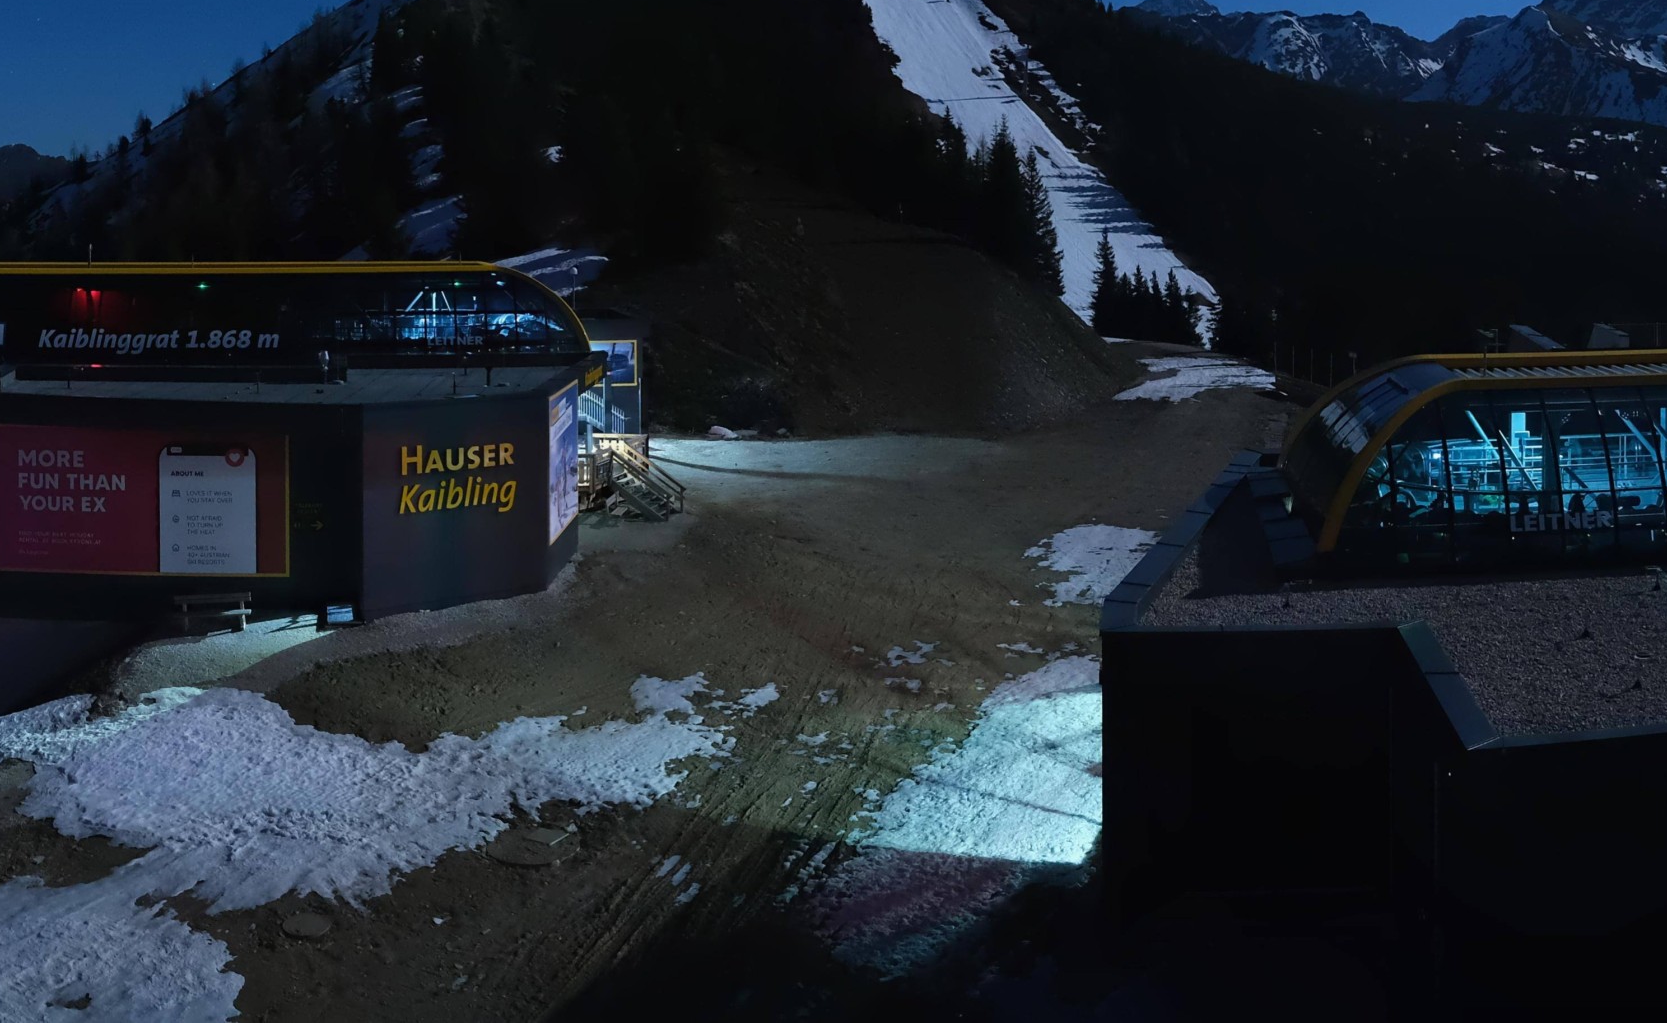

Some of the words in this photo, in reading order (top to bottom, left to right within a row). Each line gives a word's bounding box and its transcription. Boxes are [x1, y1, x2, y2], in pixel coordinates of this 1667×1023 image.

[38, 328, 179, 355] Kaiblinggrat
[185, 330, 252, 349] 1.868
[257, 332, 280, 349] m
[427, 336, 484, 346] LEITNER
[18, 449, 84, 468] MORE
[401, 442, 515, 476] HAUSER
[18, 472, 59, 489] FUN
[66, 473, 126, 491] THAN
[19, 495, 75, 512] YOUR
[81, 496, 107, 513] EX
[399, 476, 517, 515] Kaibling
[1510, 510, 1614, 532] LEITNER
